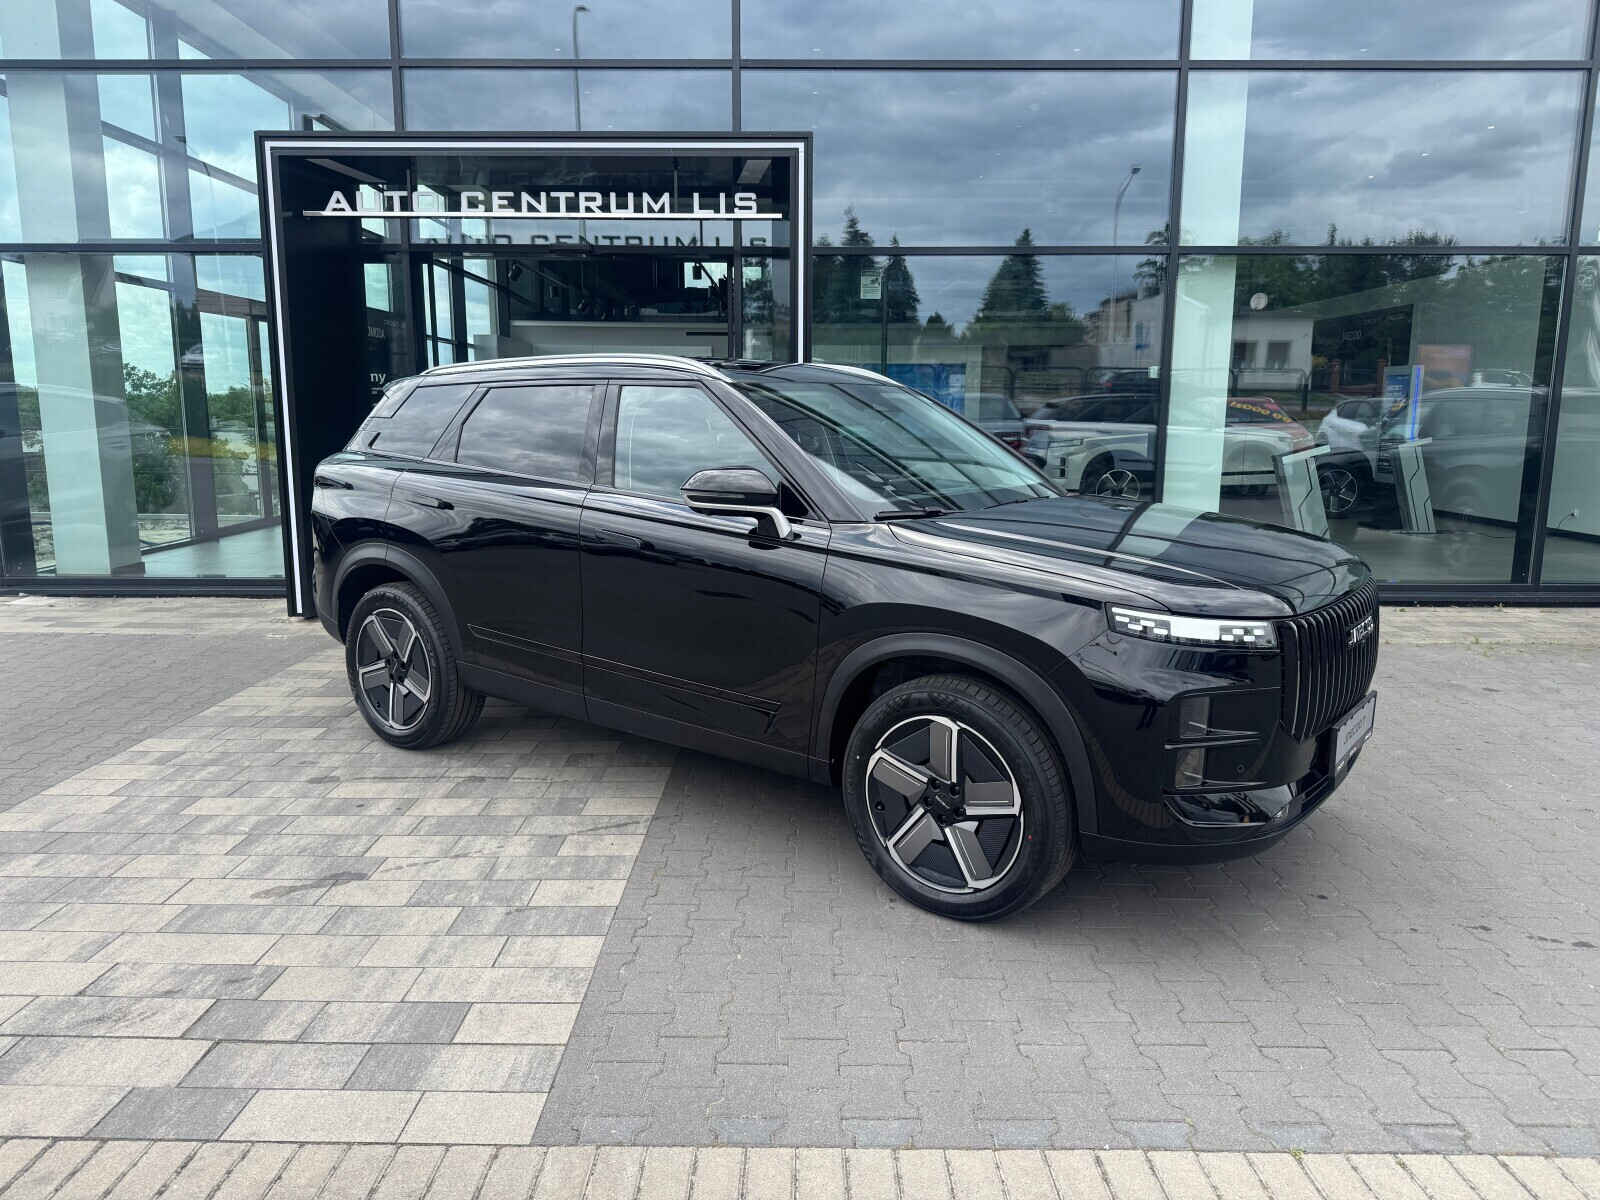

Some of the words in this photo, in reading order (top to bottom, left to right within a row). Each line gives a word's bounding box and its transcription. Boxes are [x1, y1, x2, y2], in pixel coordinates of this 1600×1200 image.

[324, 190, 439, 213] AUTO
[460, 191, 671, 214] CENTRUM
[692, 192, 758, 215] LIS
